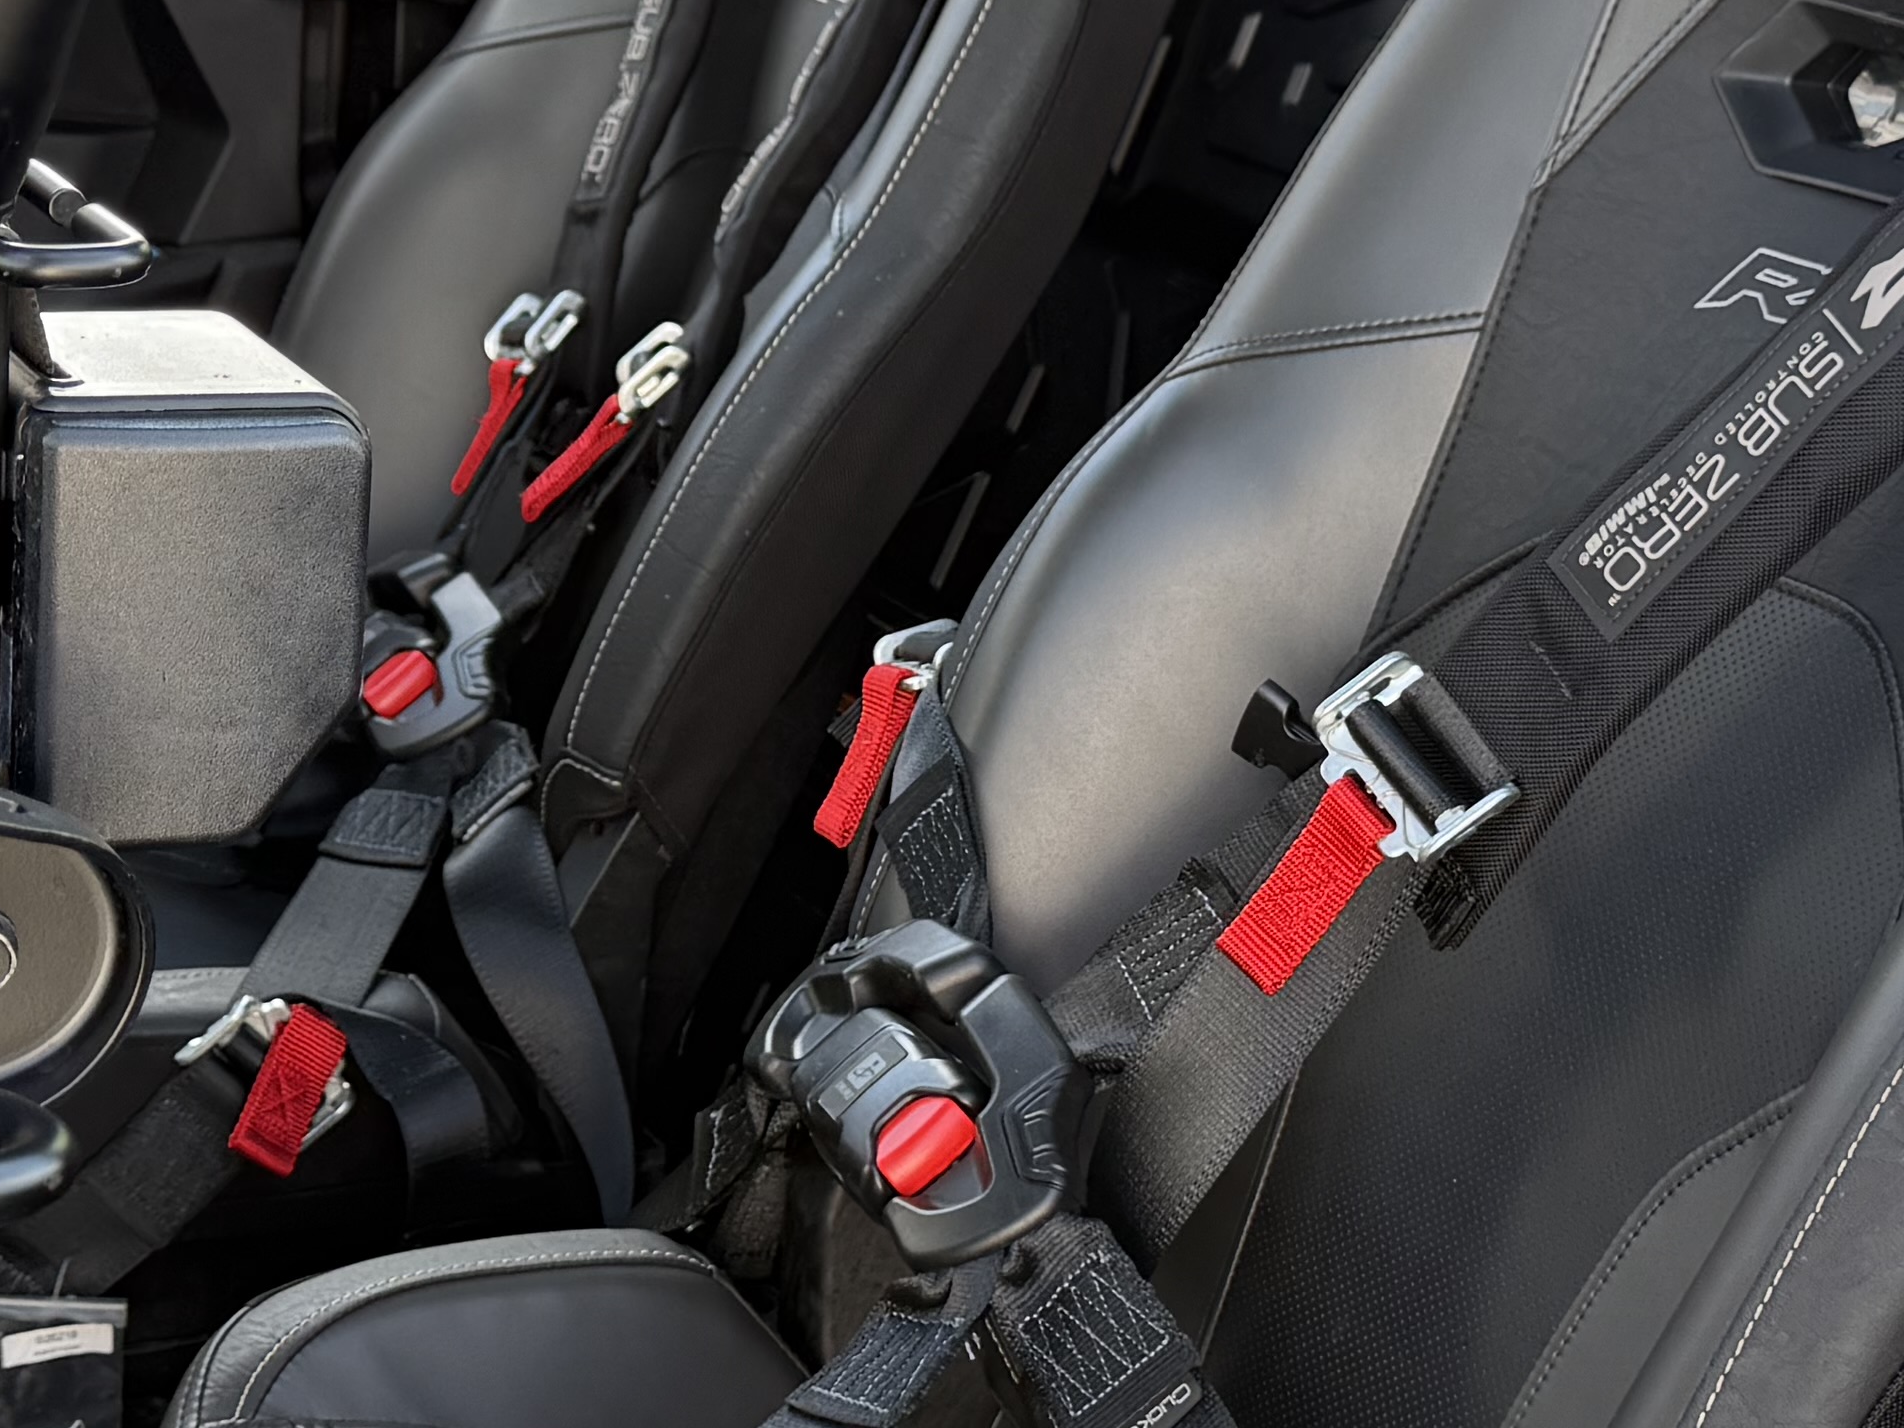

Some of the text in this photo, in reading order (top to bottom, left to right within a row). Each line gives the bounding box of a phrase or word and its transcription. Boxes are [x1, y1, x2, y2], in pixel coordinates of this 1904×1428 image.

[1713, 330, 1827, 447] CONTROLLED
[1736, 342, 1844, 457] SUB
[1592, 453, 1709, 570] DECELERATOR
